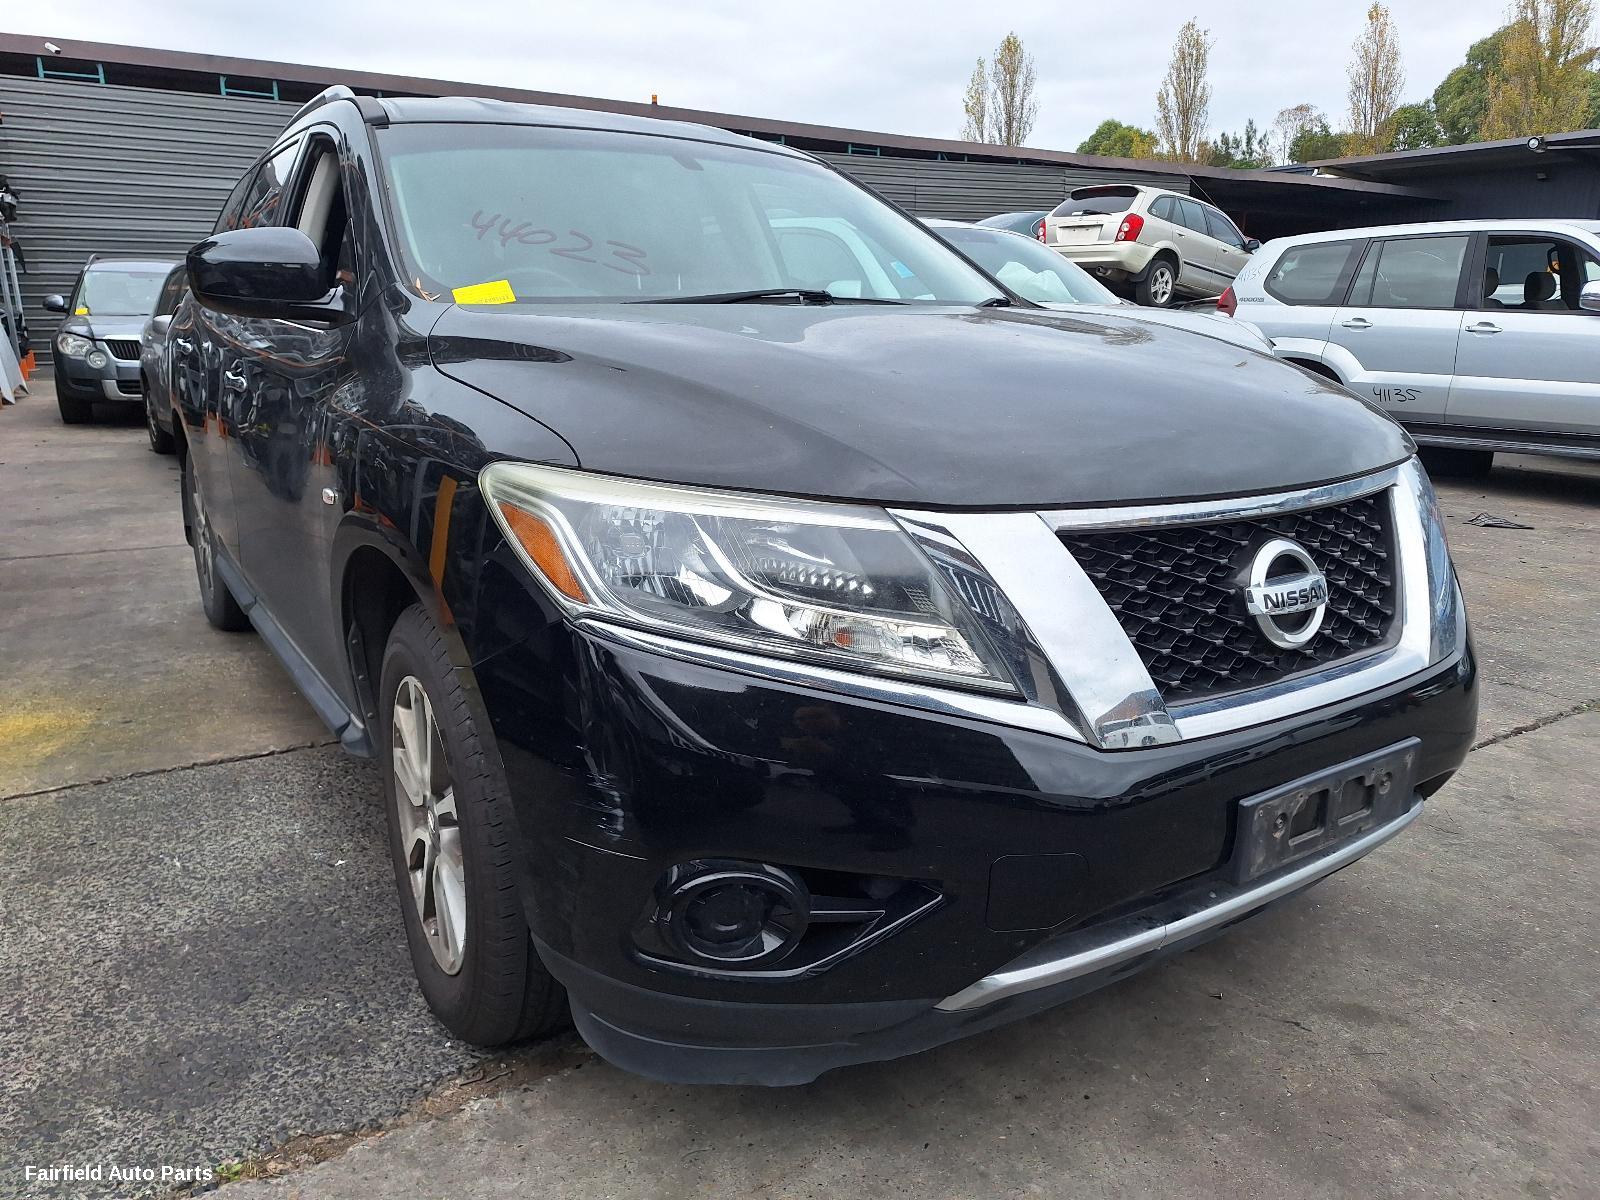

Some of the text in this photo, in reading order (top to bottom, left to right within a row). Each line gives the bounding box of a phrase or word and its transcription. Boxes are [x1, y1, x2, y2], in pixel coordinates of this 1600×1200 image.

[472, 210, 651, 275] 44023
[1373, 385, 1422, 402] 41135
[1263, 584, 1326, 609] NISSAN
